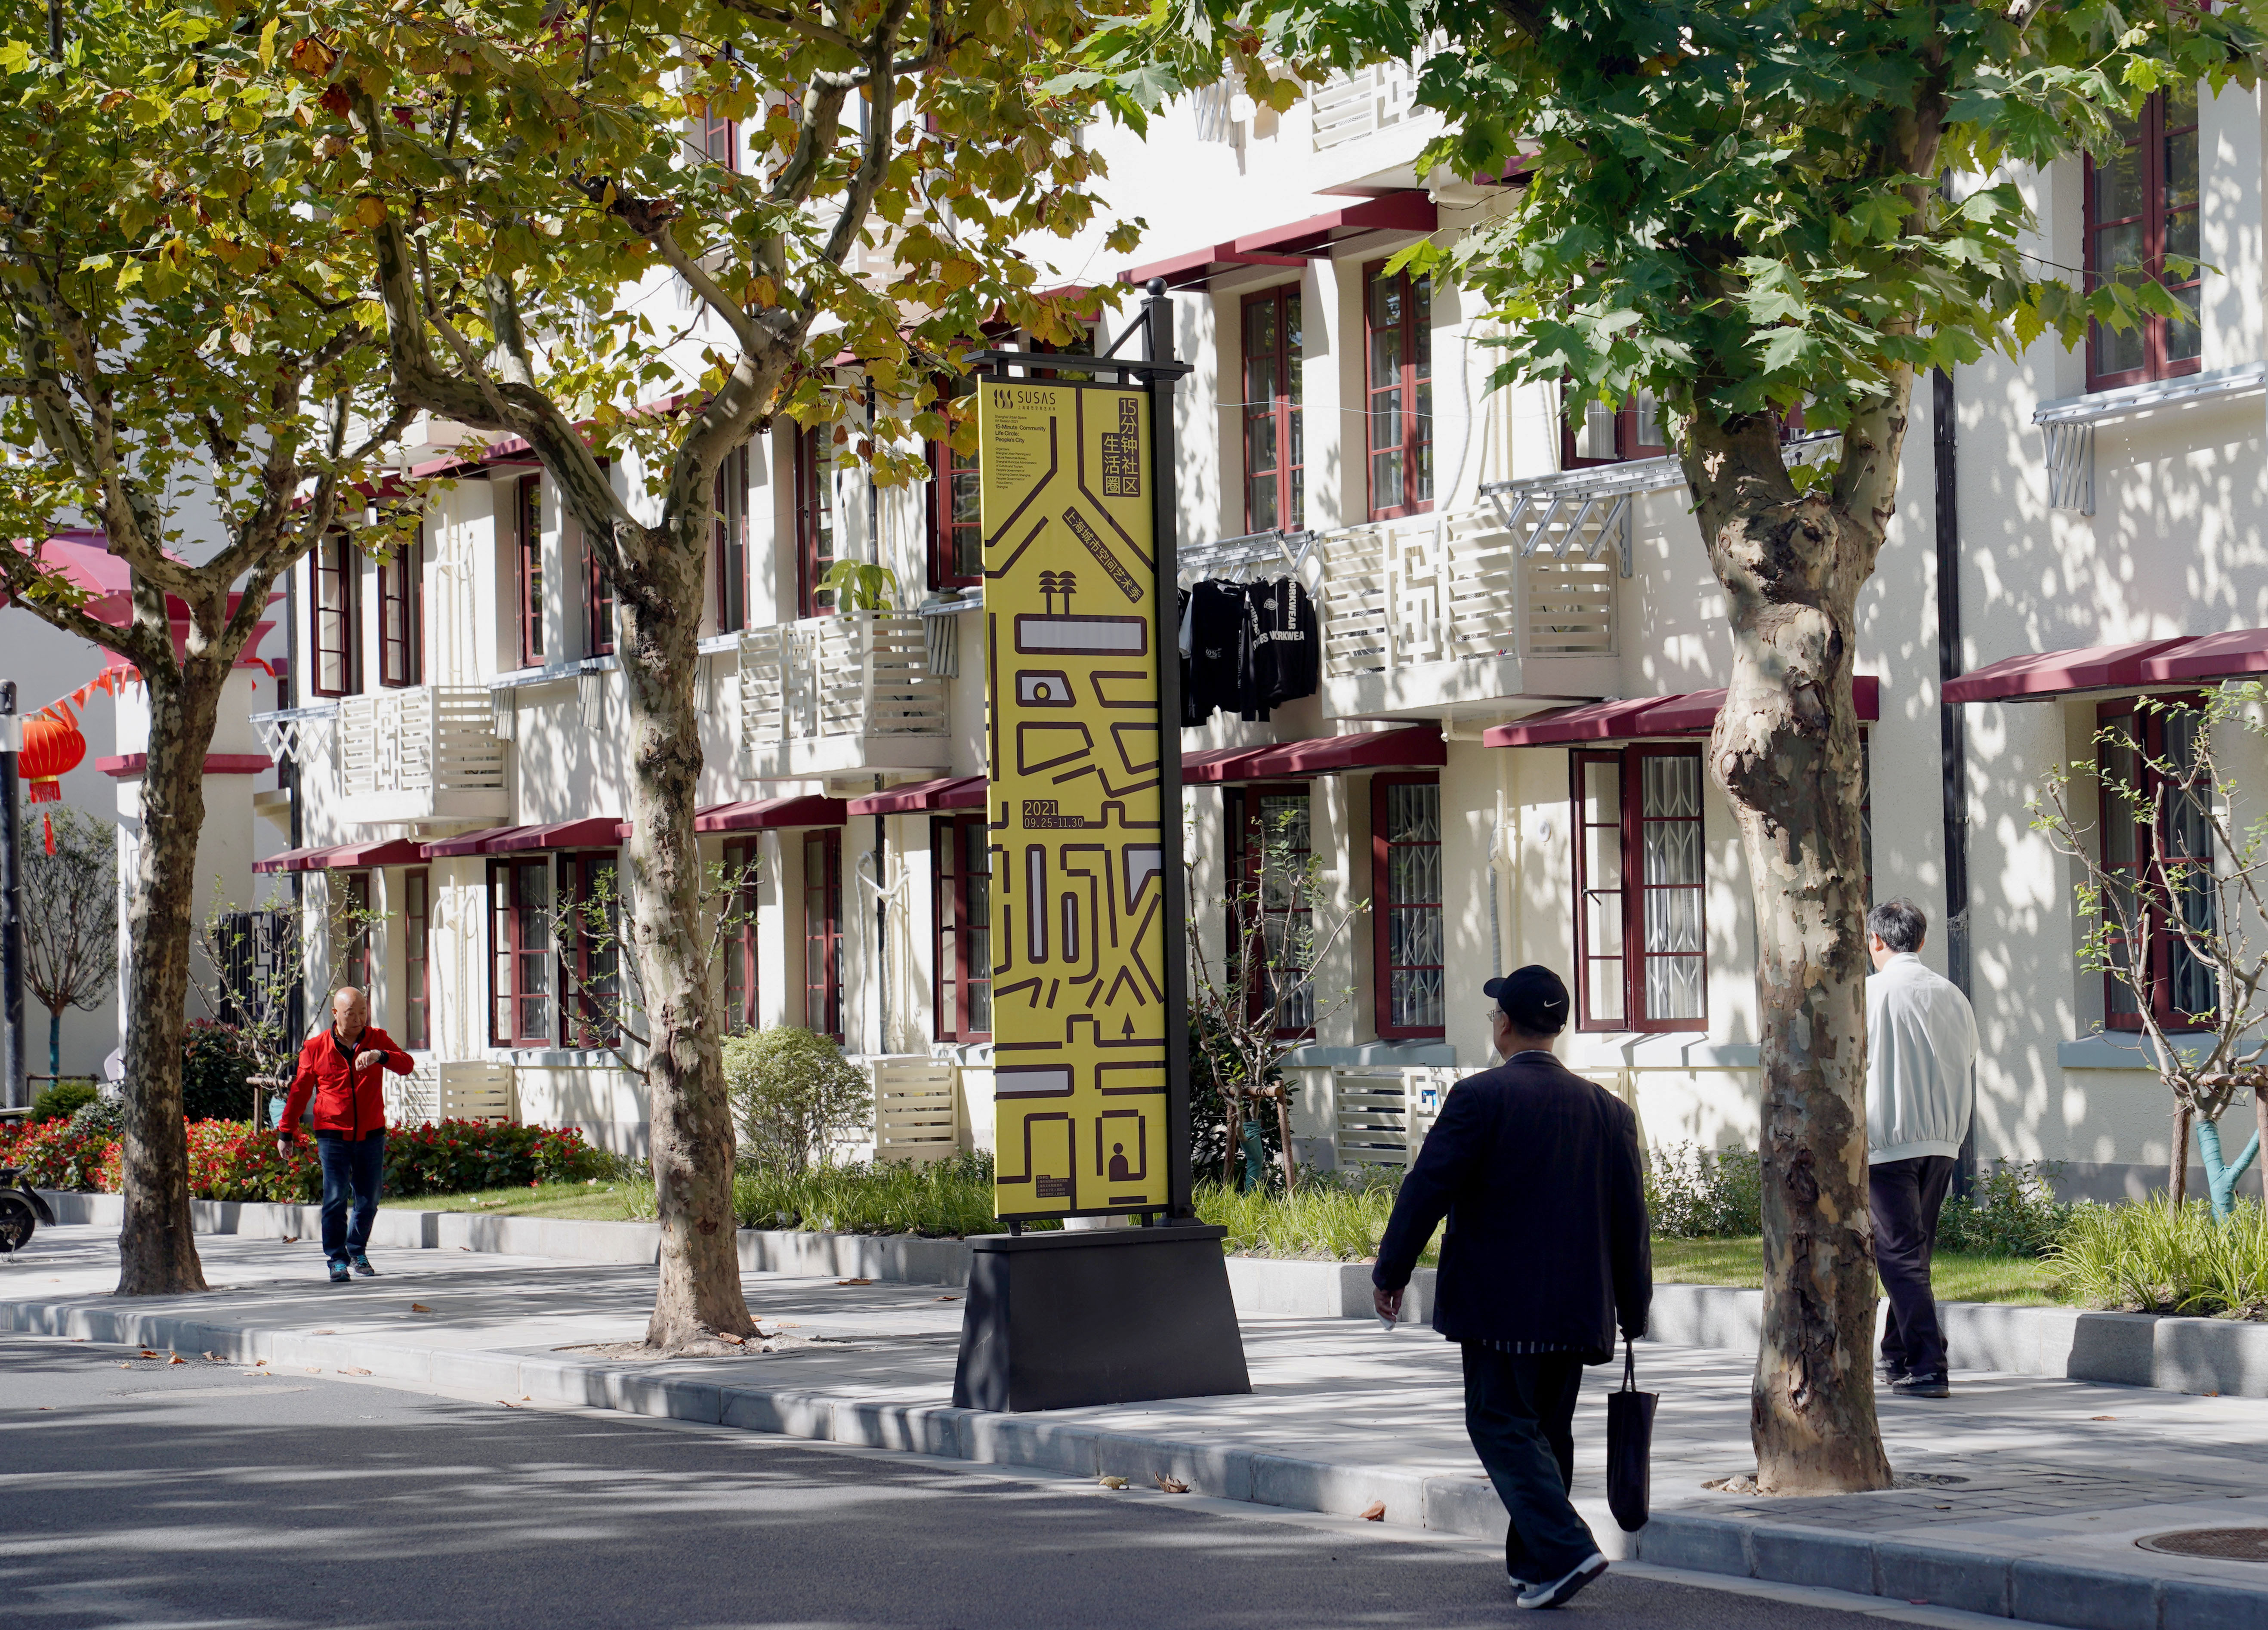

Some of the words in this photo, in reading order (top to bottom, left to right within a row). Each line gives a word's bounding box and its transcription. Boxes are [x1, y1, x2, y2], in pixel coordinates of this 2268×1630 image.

[1018, 391, 1055, 405] SUSAS
[1104, 435, 1120, 494] 生活圈
[1120, 399, 1139, 494] 15分钟社区
[1064, 511, 1141, 600] 上海城市空间艺术季
[1024, 801, 1057, 816] 2021
[1024, 818, 1083, 828] 09.25-11.30
